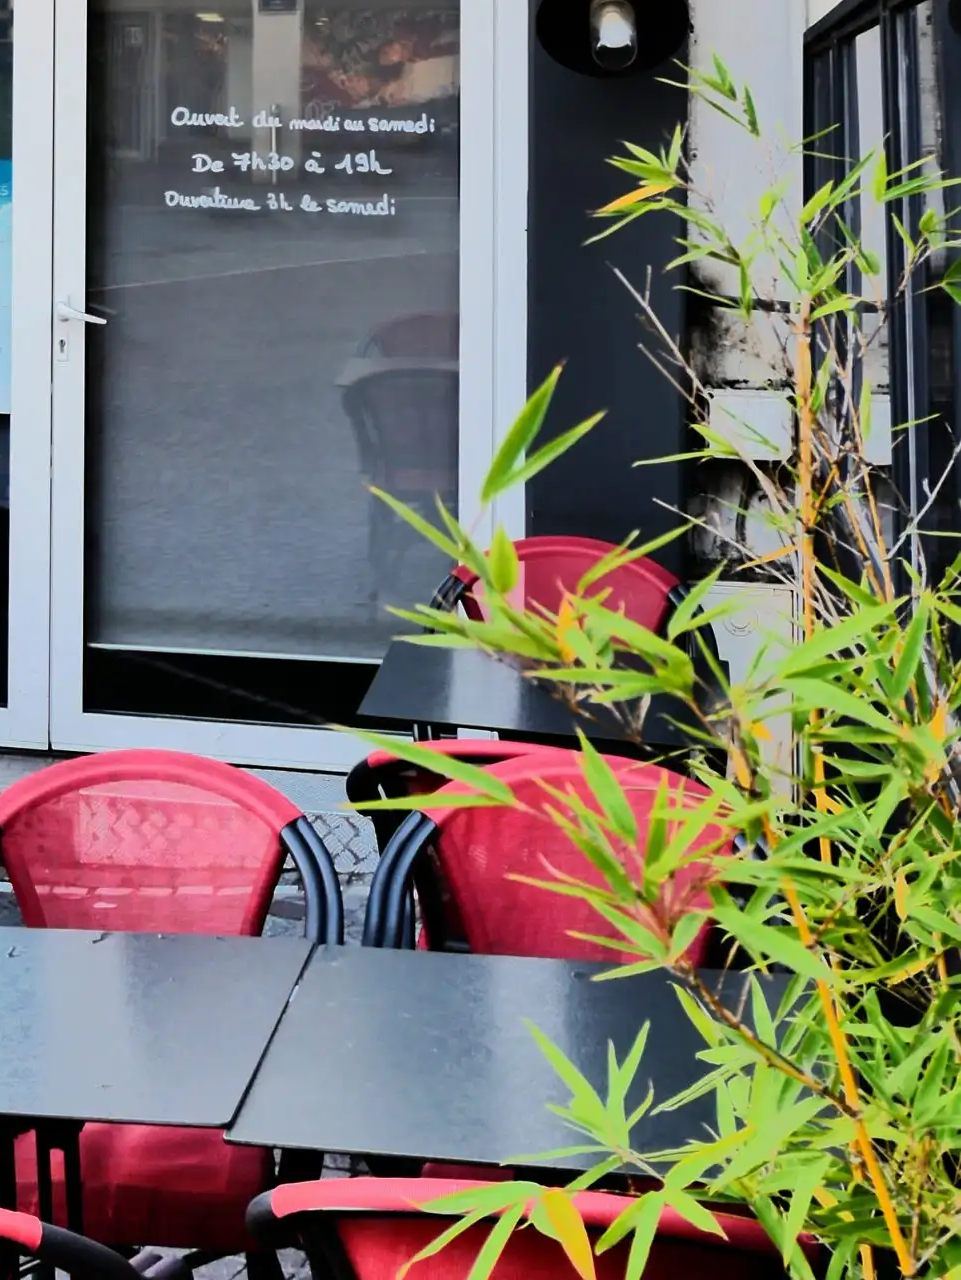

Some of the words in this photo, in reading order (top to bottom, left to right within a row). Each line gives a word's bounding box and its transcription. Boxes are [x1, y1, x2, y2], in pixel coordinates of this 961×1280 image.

[252, 110, 283, 128] du
[289, 116, 341, 132] mardi
[344, 118, 365, 132] au
[367, 113, 435, 134] samedi
[191, 153, 225, 173] De
[231, 151, 295, 172] 7h30
[304, 151, 326, 174] à
[334, 149, 393, 175] 19h
[300, 194, 322, 212] le
[326, 193, 396, 216] samedi
